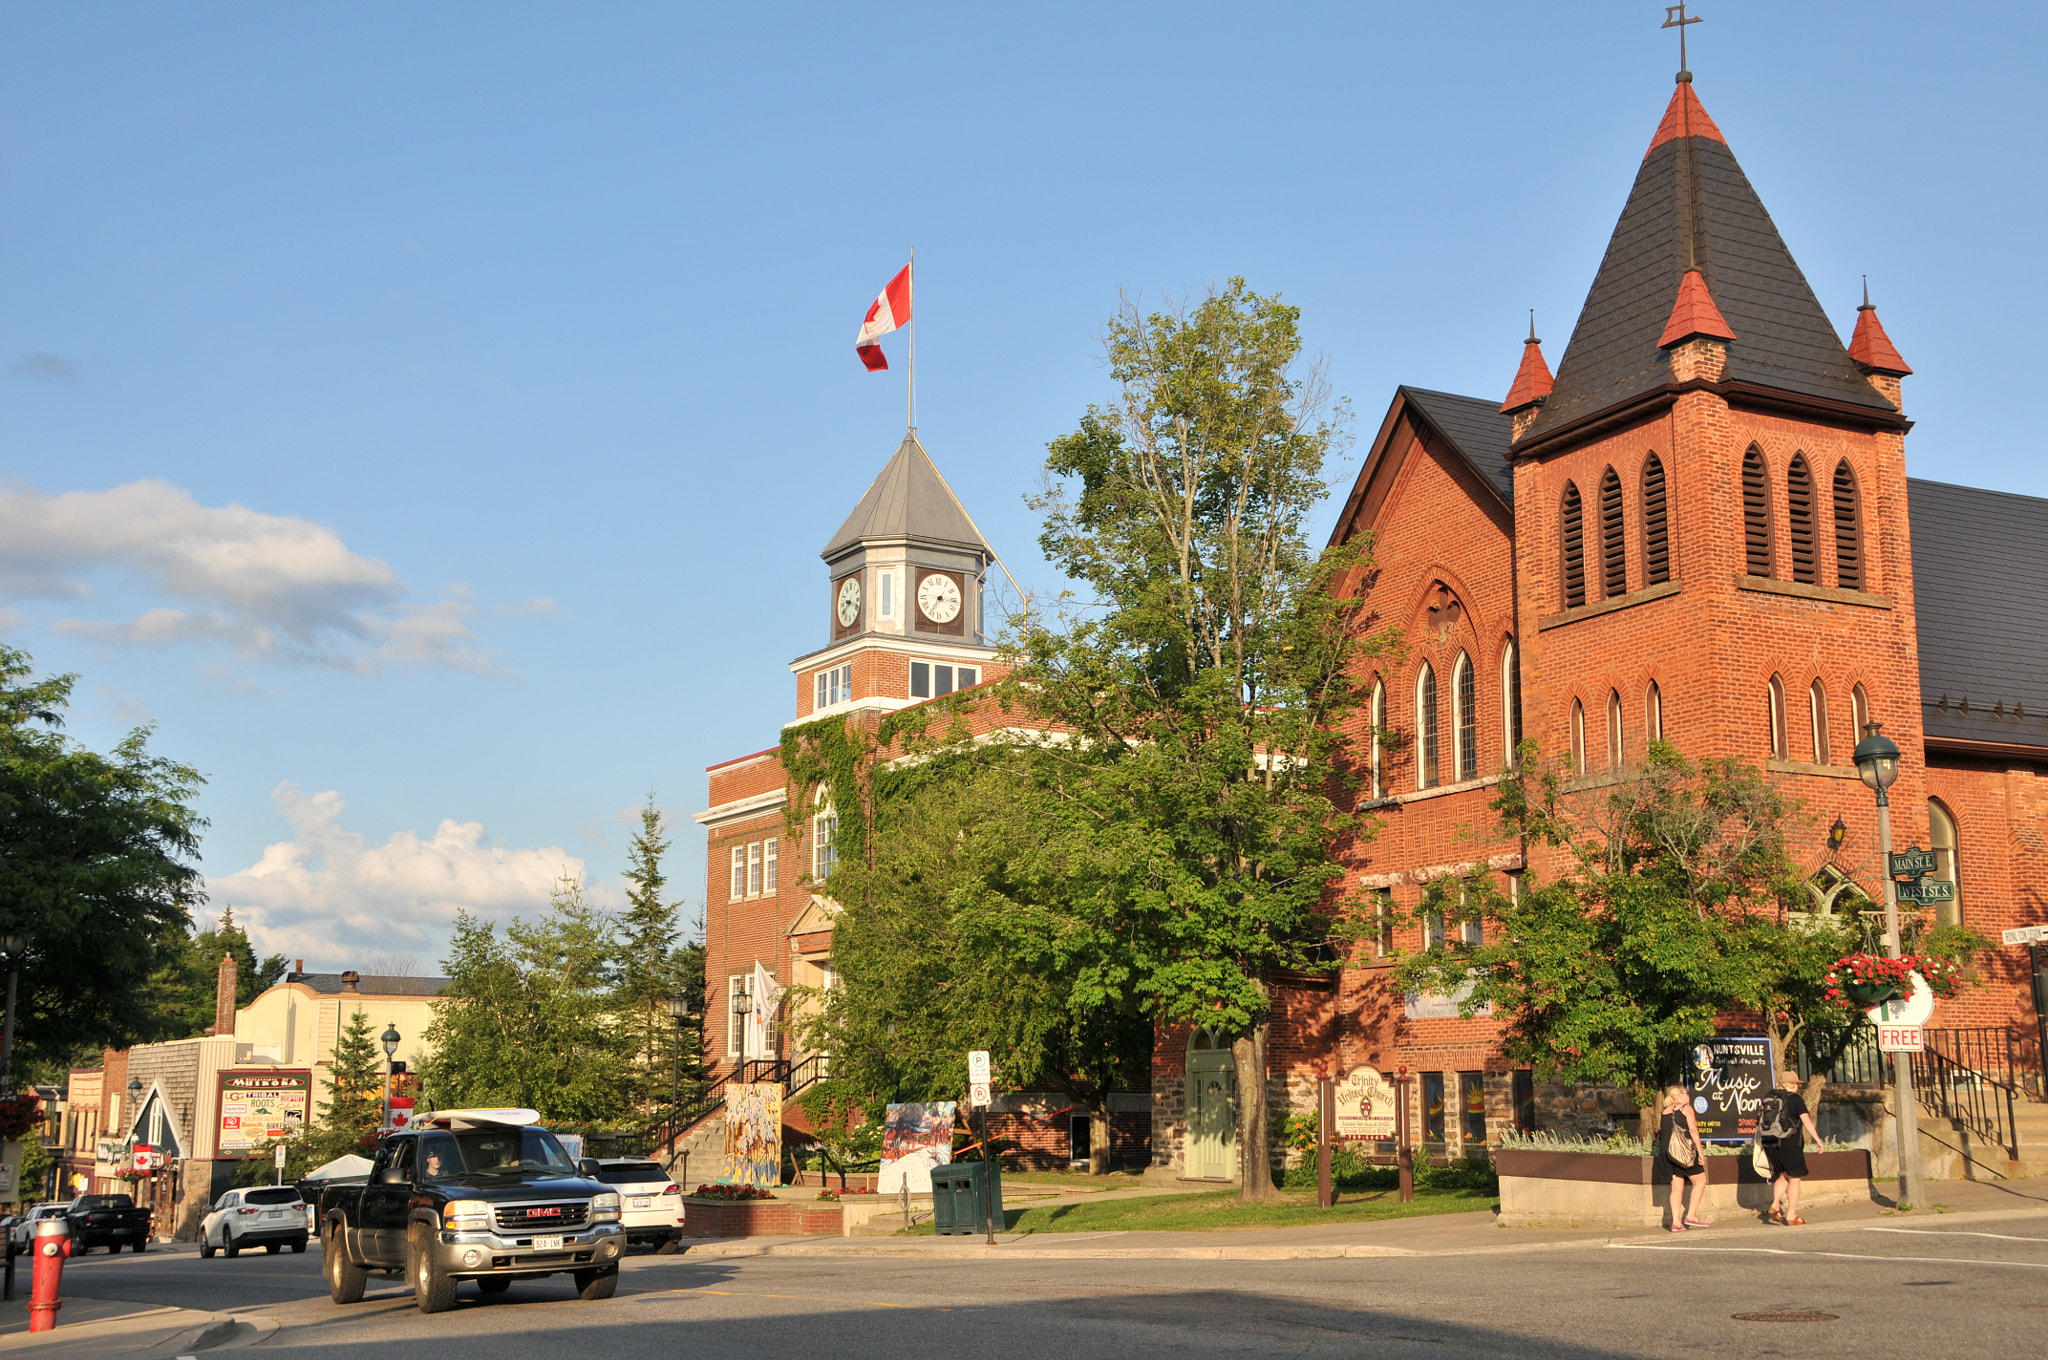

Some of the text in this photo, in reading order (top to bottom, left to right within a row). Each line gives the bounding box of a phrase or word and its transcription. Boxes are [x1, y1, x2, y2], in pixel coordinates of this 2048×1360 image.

[1894, 856, 1932, 870] MAIN ST. E.
[1902, 886, 1950, 897] WEST ST. S.
[1881, 1029, 1920, 1046] FREE
[1713, 1044, 1764, 1056] HUNTSVILLE
[1752, 1058, 1766, 1066] arts
[232, 1078, 298, 1087] MUSKOKA
[1352, 1074, 1379, 1086] Trinity
[1694, 1067, 1761, 1092] Music
[225, 1092, 244, 1101] UGG
[1337, 1086, 1394, 1108] United Church
[1712, 1087, 1762, 1115] at Noon
[251, 1099, 275, 1108] ROOTS
[526, 1207, 561, 1218] GMC
